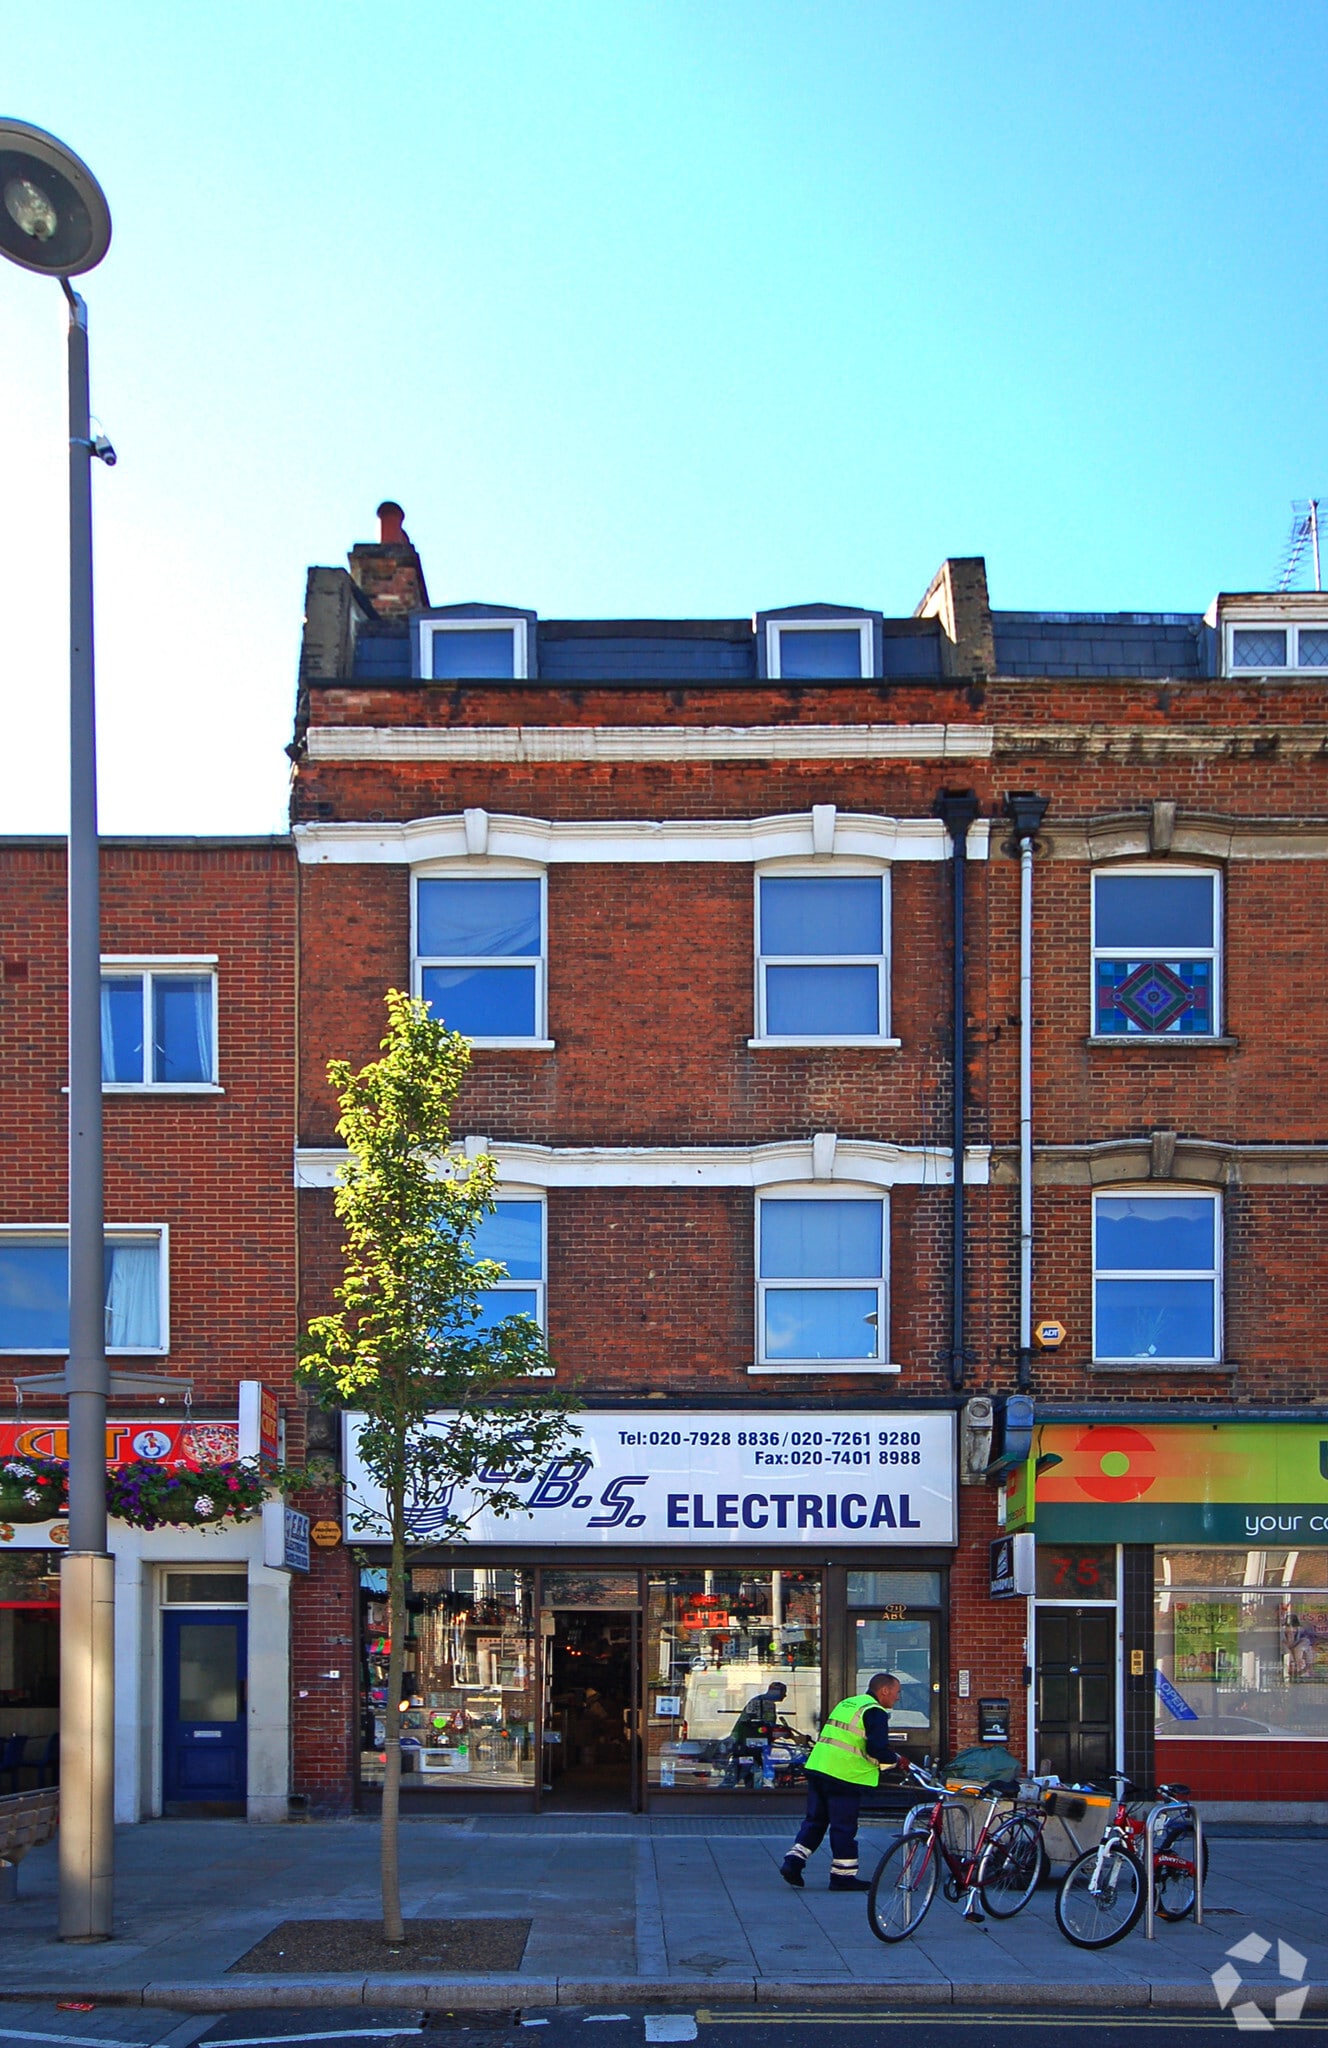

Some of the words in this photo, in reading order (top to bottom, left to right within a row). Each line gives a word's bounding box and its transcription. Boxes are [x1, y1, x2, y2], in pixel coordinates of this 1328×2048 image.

[737, 1431, 871, 1447] 8836/020-7261
[878, 1431, 921, 1446] 9280
[755, 1451, 871, 1465] Fax:020-7401
[878, 1451, 921, 1465] 8988
[667, 1494, 921, 1528] ELECTRICAL
[1245, 1515, 1303, 1536] your
[1050, 1558, 1101, 1586] 75
[1161, 1682, 1188, 1713] OPEN
